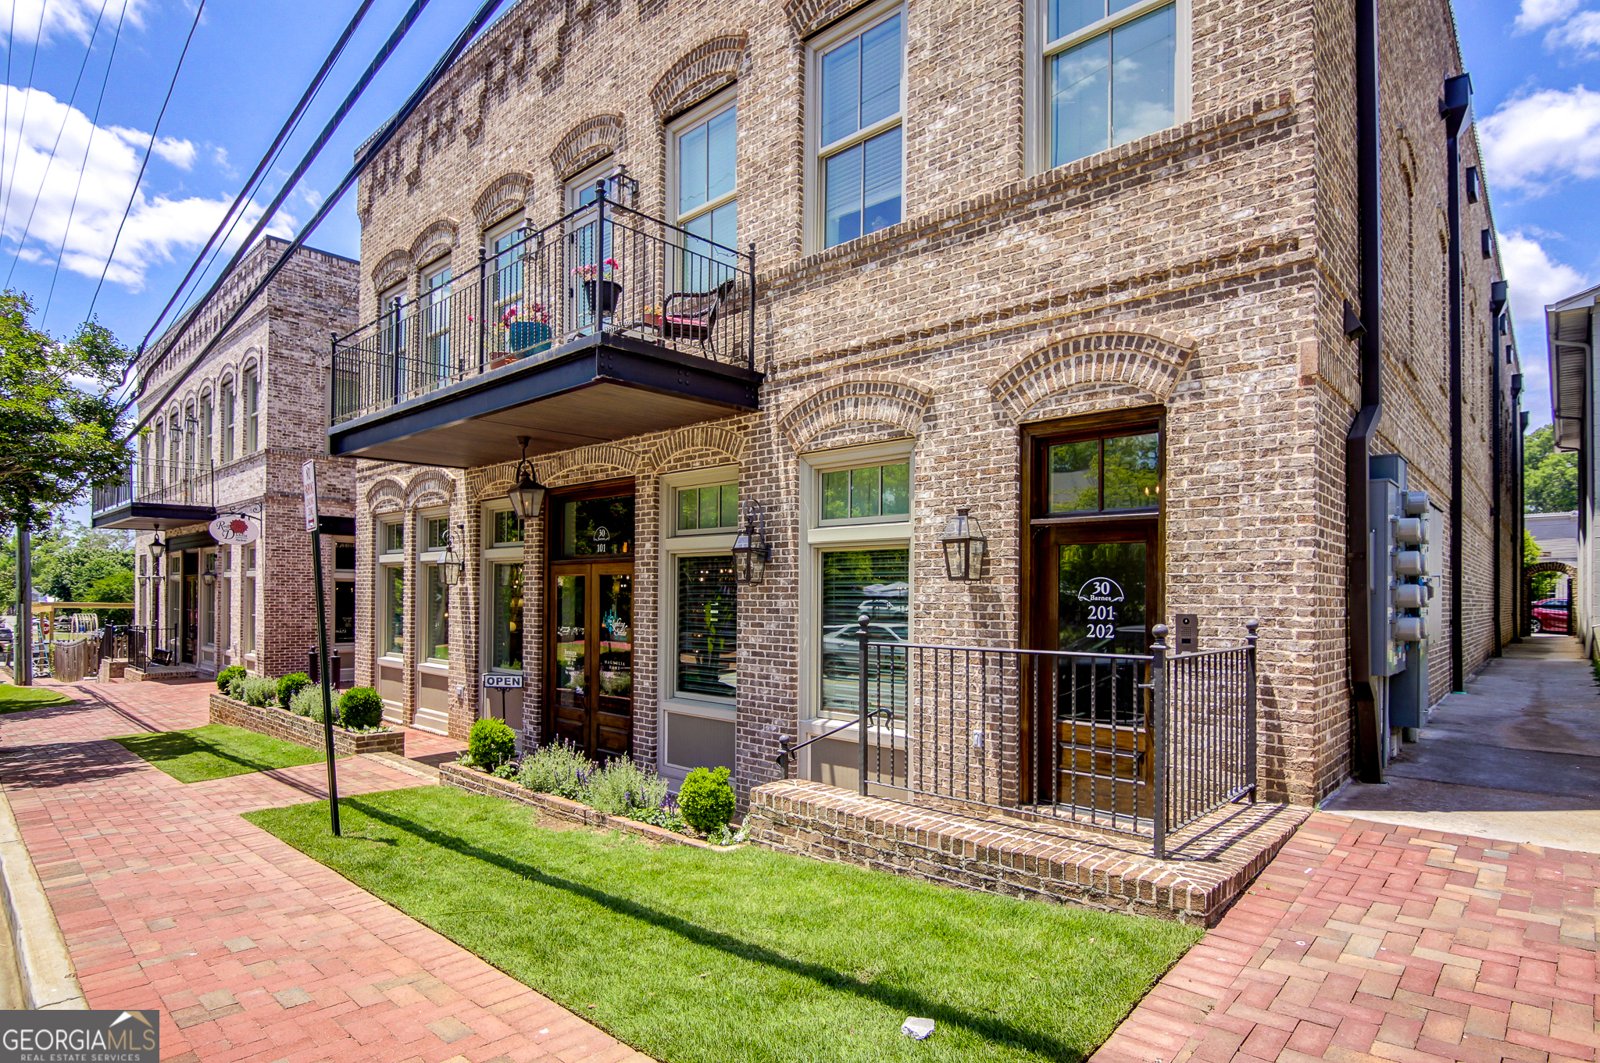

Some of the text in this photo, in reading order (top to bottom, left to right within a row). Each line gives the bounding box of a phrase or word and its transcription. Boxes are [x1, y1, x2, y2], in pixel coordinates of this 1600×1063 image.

[597, 543, 606, 553] 101
[1092, 581, 1110, 595] 30
[1087, 605, 1114, 620] 201
[1086, 624, 1115, 639] 202
[487, 677, 520, 686] OPEN
